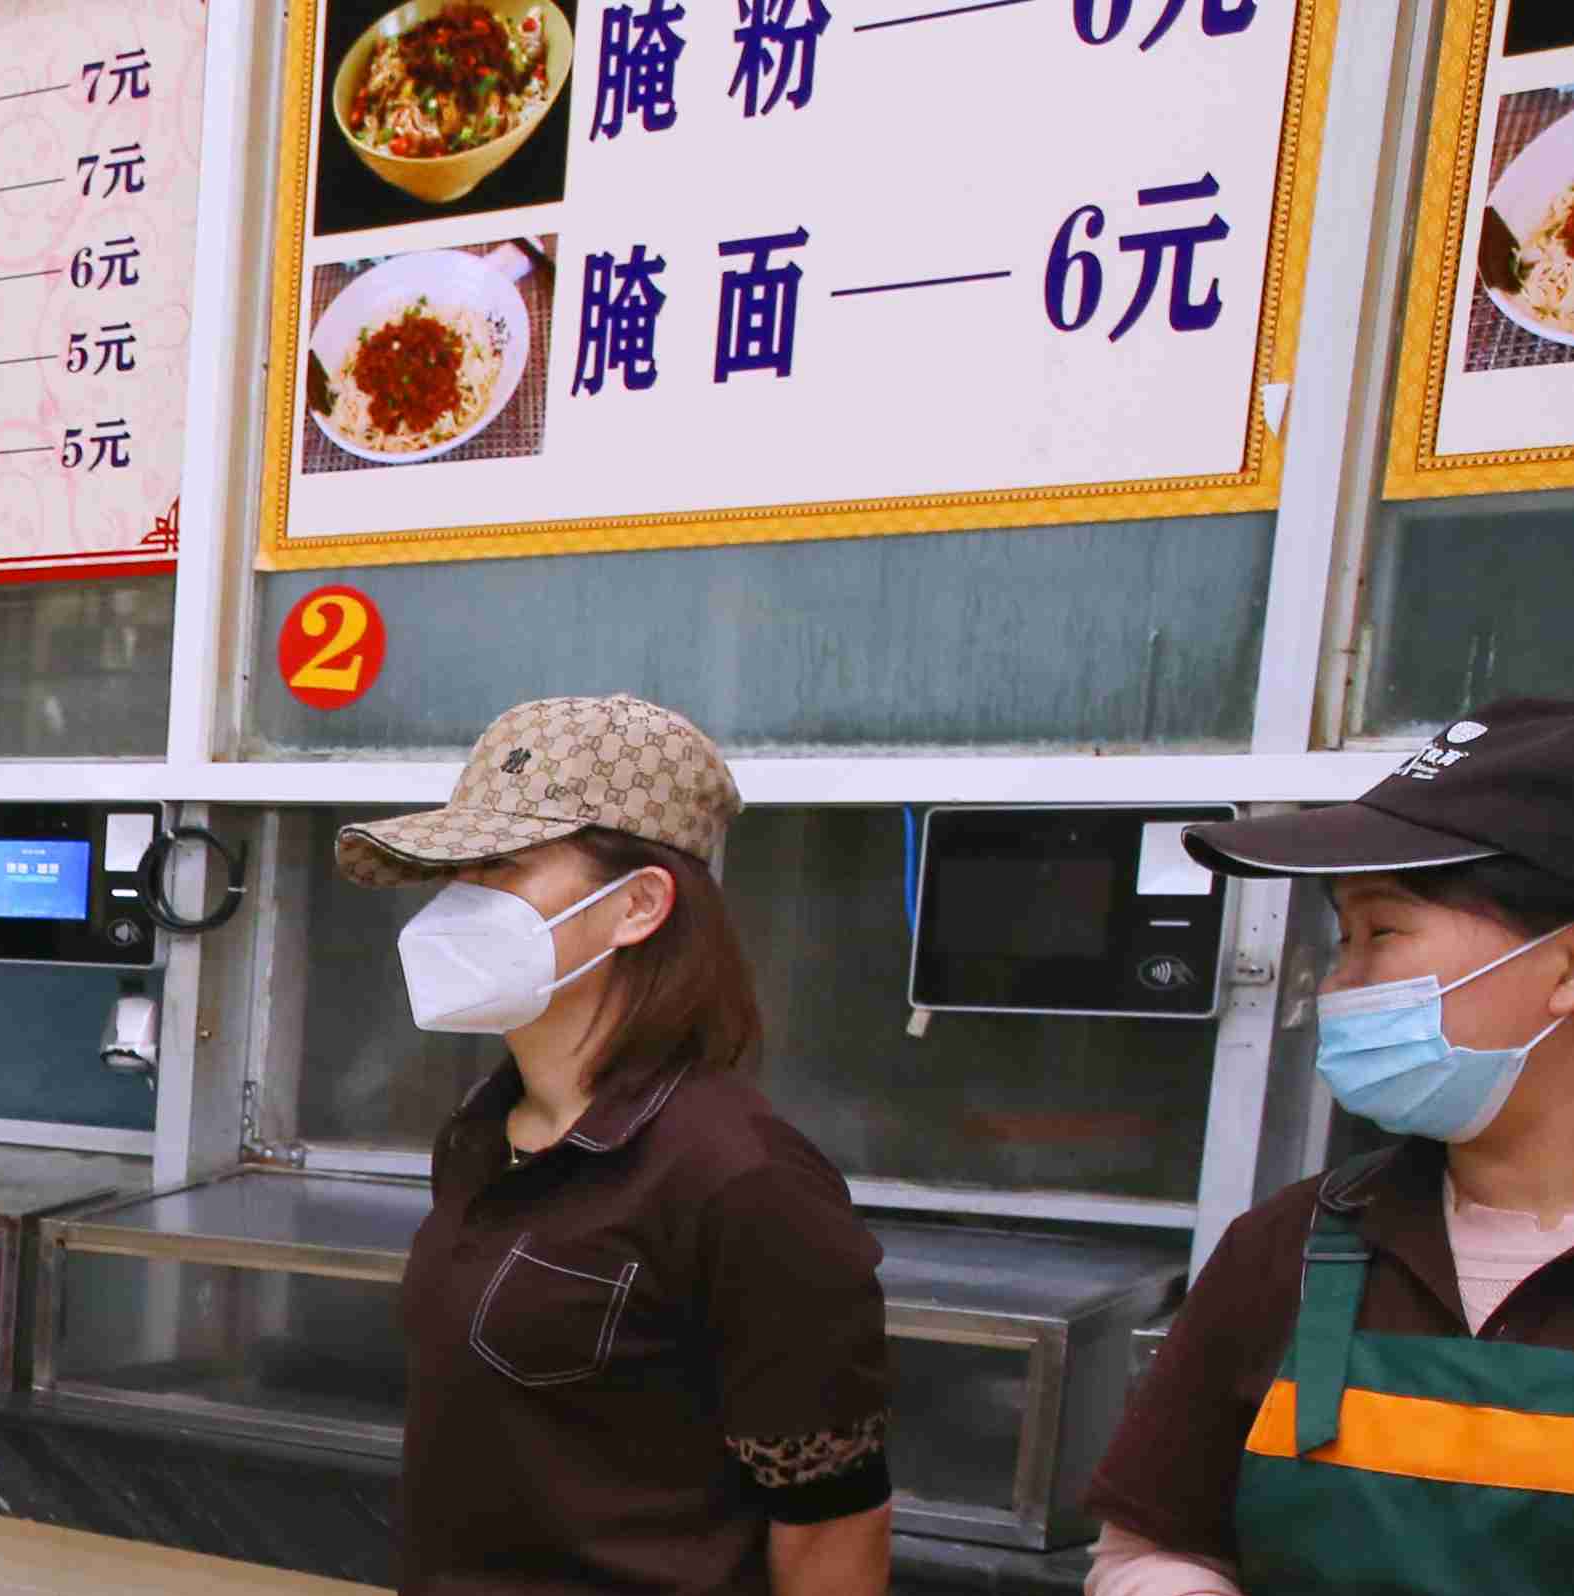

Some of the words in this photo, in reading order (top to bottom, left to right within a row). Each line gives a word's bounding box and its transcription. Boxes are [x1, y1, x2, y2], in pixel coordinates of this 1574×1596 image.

[80, 48, 152, 105] 7元
[75, 143, 147, 199] 7元
[69, 235, 142, 290] 6元
[571, 223, 809, 399] 腌面
[1045, 171, 1230, 346] 6元
[65, 321, 137, 377] 5元
[61, 418, 132, 472] 5元
[289, 595, 369, 692] 2
